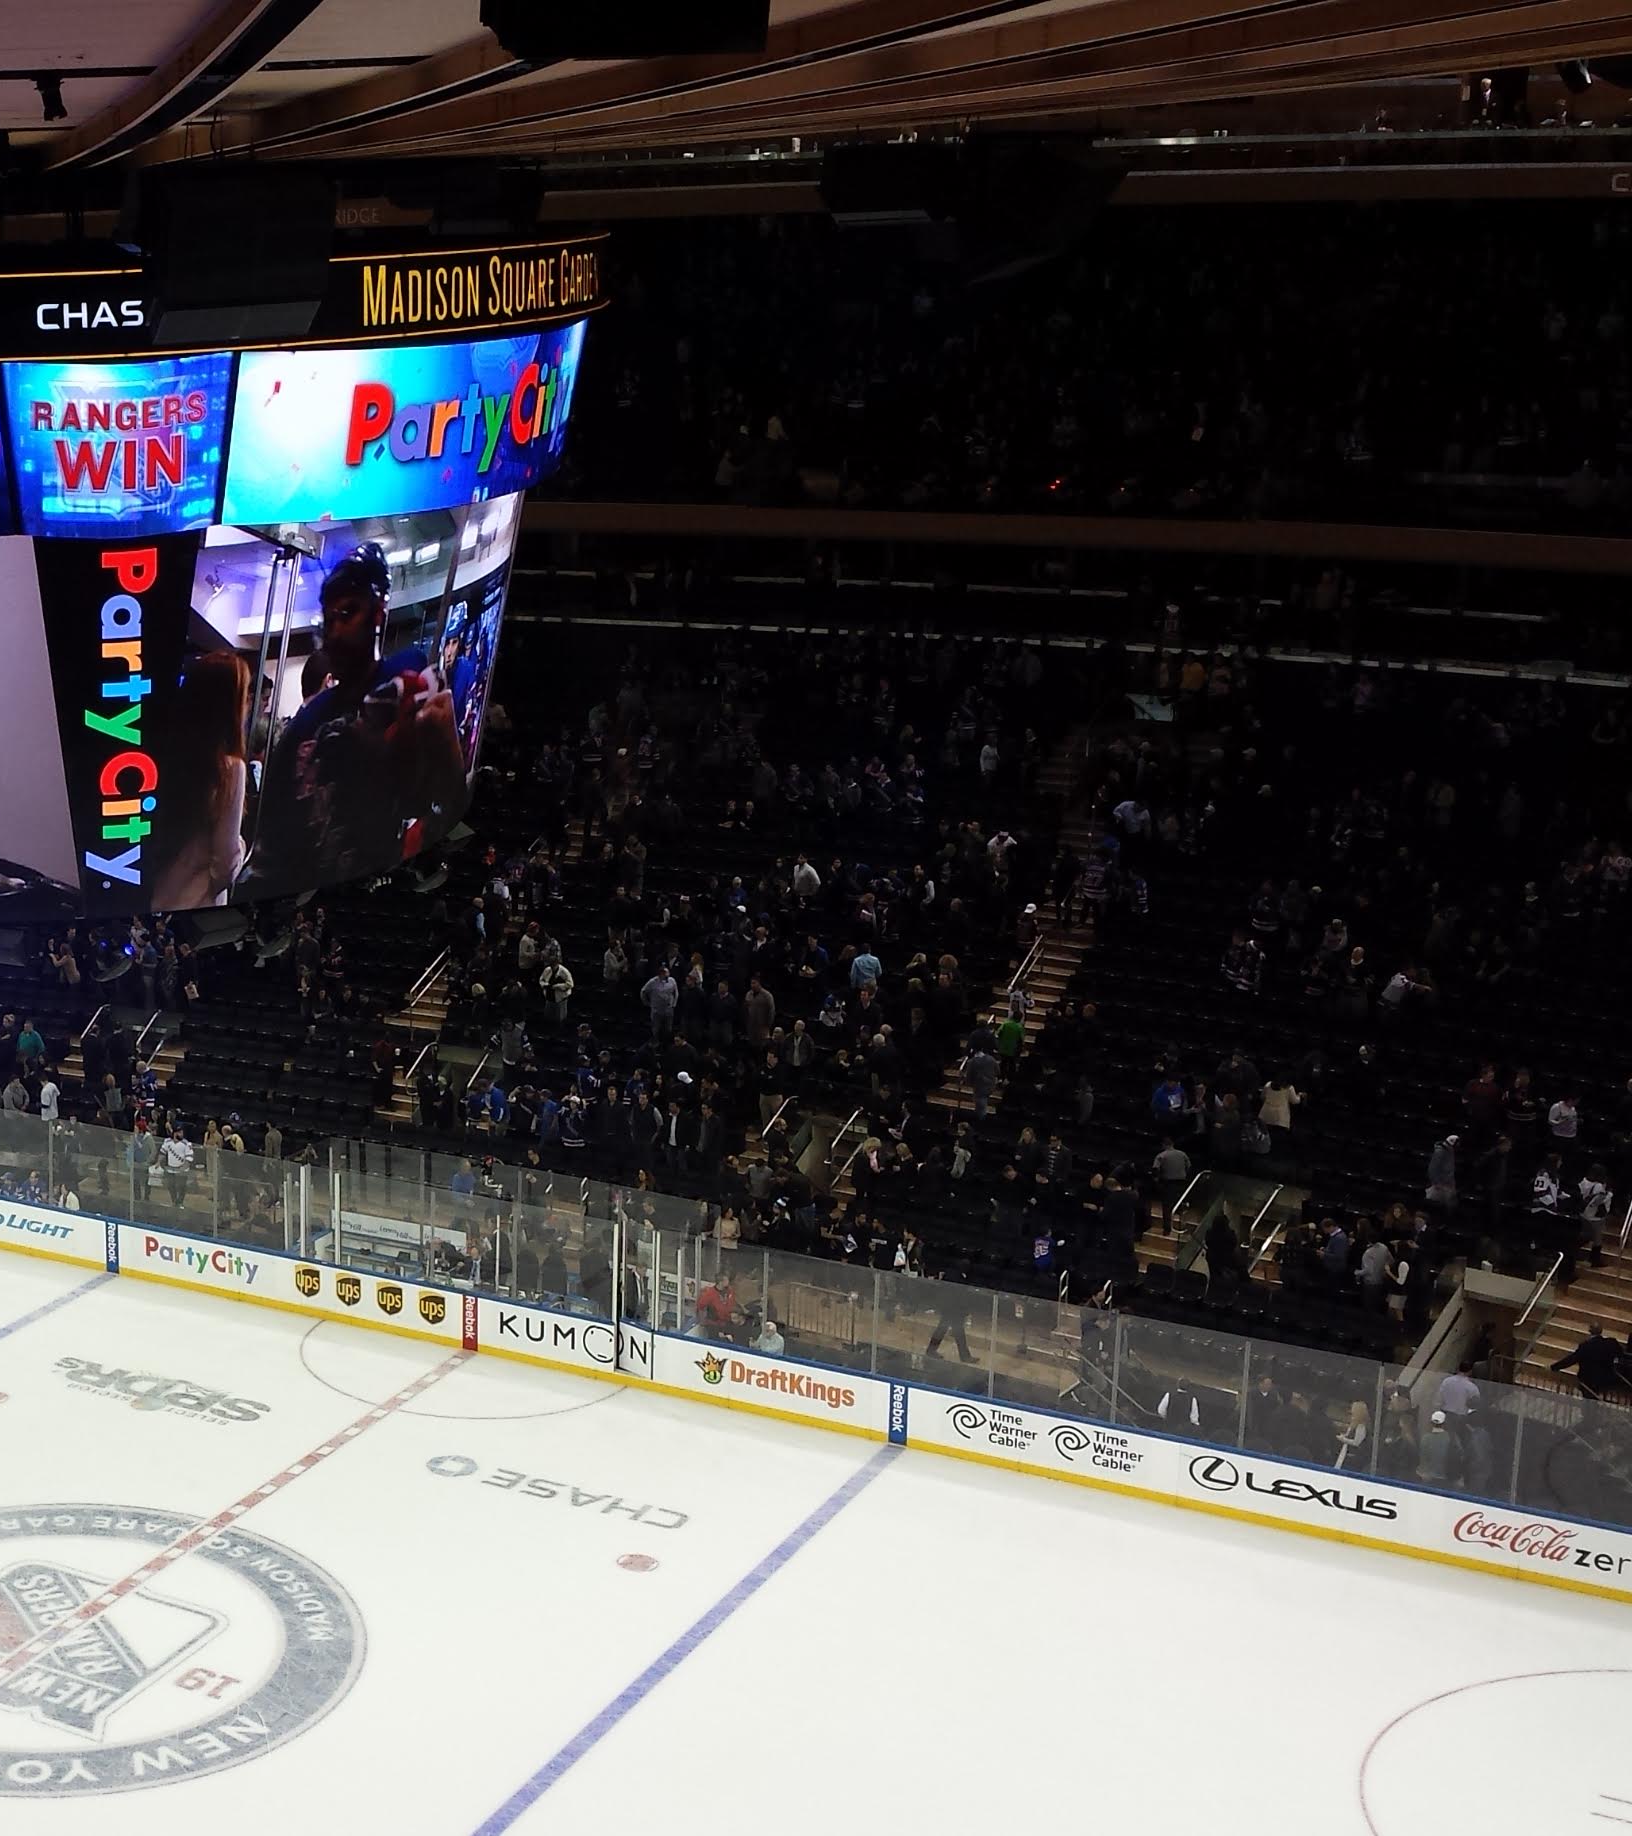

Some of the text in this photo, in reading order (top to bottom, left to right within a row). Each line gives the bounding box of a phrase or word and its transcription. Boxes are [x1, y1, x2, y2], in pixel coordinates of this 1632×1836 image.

[336, 207, 383, 225] RIDGE
[363, 264, 480, 327] MADISON
[488, 255, 555, 317] SQUARE
[36, 300, 144, 330] CHAS
[30, 390, 207, 432] RANGERS
[54, 434, 186, 495] WIN
[7, 1214, 74, 1240] LIGHT
[107, 1222, 118, 1264] Reebok
[296, 1274, 319, 1294] ups
[336, 1282, 360, 1302] ups
[378, 1291, 402, 1312] ups
[420, 1300, 445, 1320] ups
[465, 1295, 475, 1340] Reebok
[499, 1311, 647, 1365] KUMON
[730, 1360, 856, 1409] DraftKings
[892, 1384, 905, 1433] Reebok
[990, 1409, 1023, 1425] Time
[988, 1432, 1027, 1450] Cable
[989, 1421, 1038, 1440] Warner
[1093, 1430, 1128, 1447] Time
[1092, 1454, 1132, 1472] Cable
[1093, 1442, 1144, 1462] Warner
[481, 1467, 689, 1530] CHASE
[1244, 1473, 1399, 1520] LEXUS
[1573, 1547, 1632, 1575] zer
[252, 1556, 335, 1643] MADISON
[6, 1674, 113, 1714] NEW
[176, 1667, 242, 1701] 19
[133, 1715, 272, 1779] NEW
